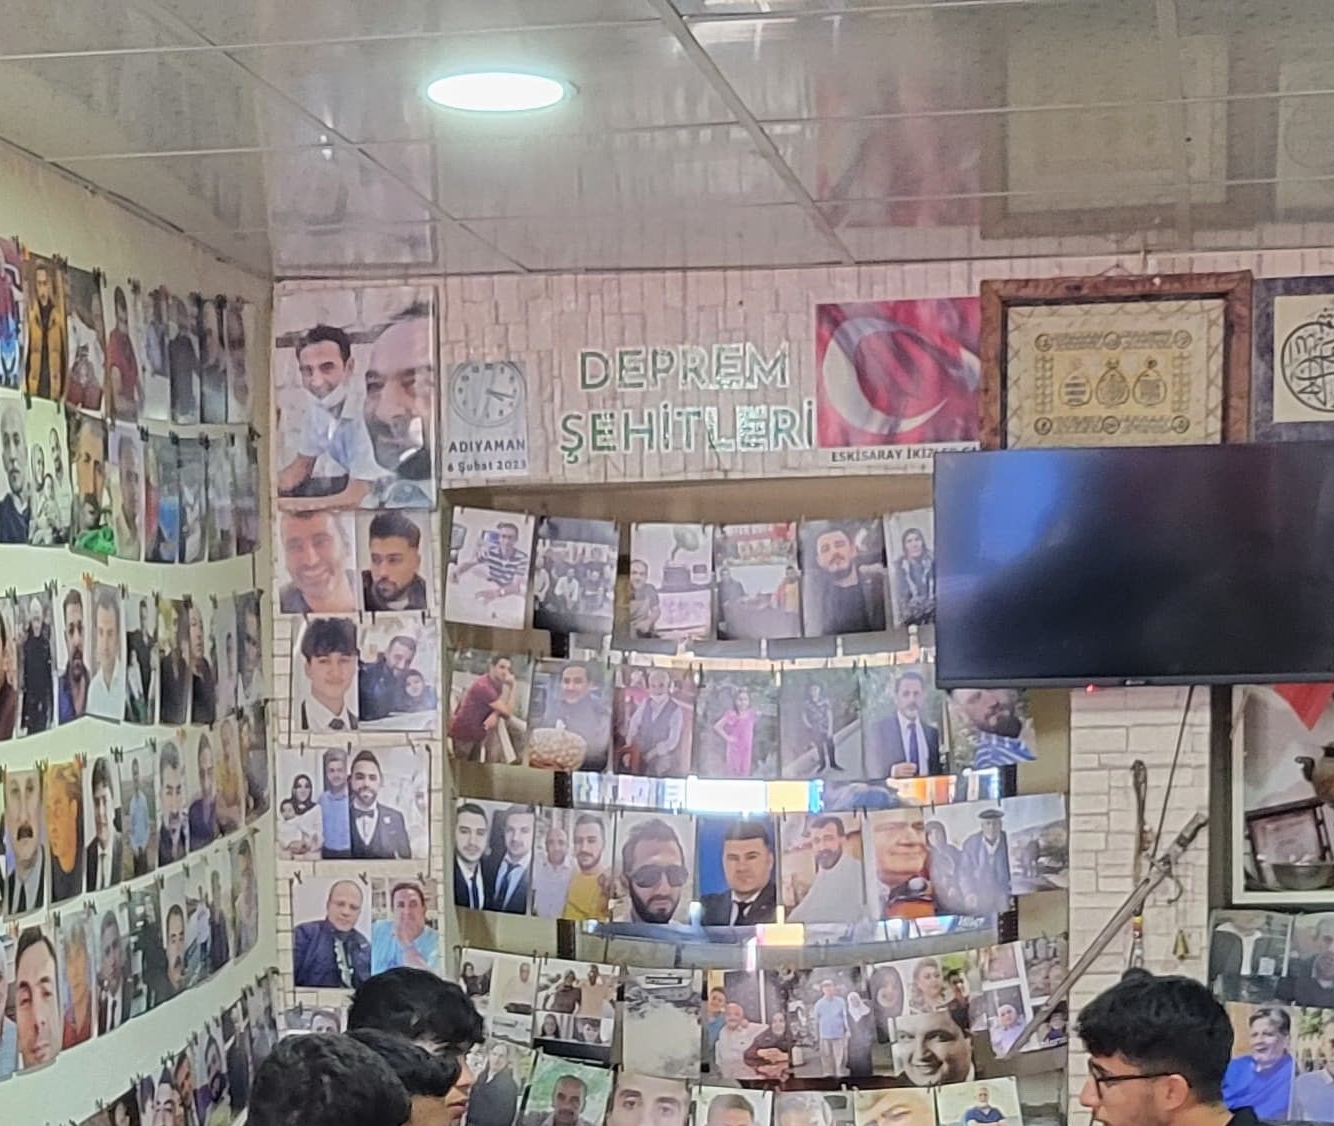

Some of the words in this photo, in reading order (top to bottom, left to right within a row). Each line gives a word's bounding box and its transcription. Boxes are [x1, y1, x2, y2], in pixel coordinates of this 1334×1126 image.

[579, 341, 790, 391] DEPREM
[449, 439, 525, 453] ADIYAMAN
[560, 399, 816, 465] ŞEHİTLERİ
